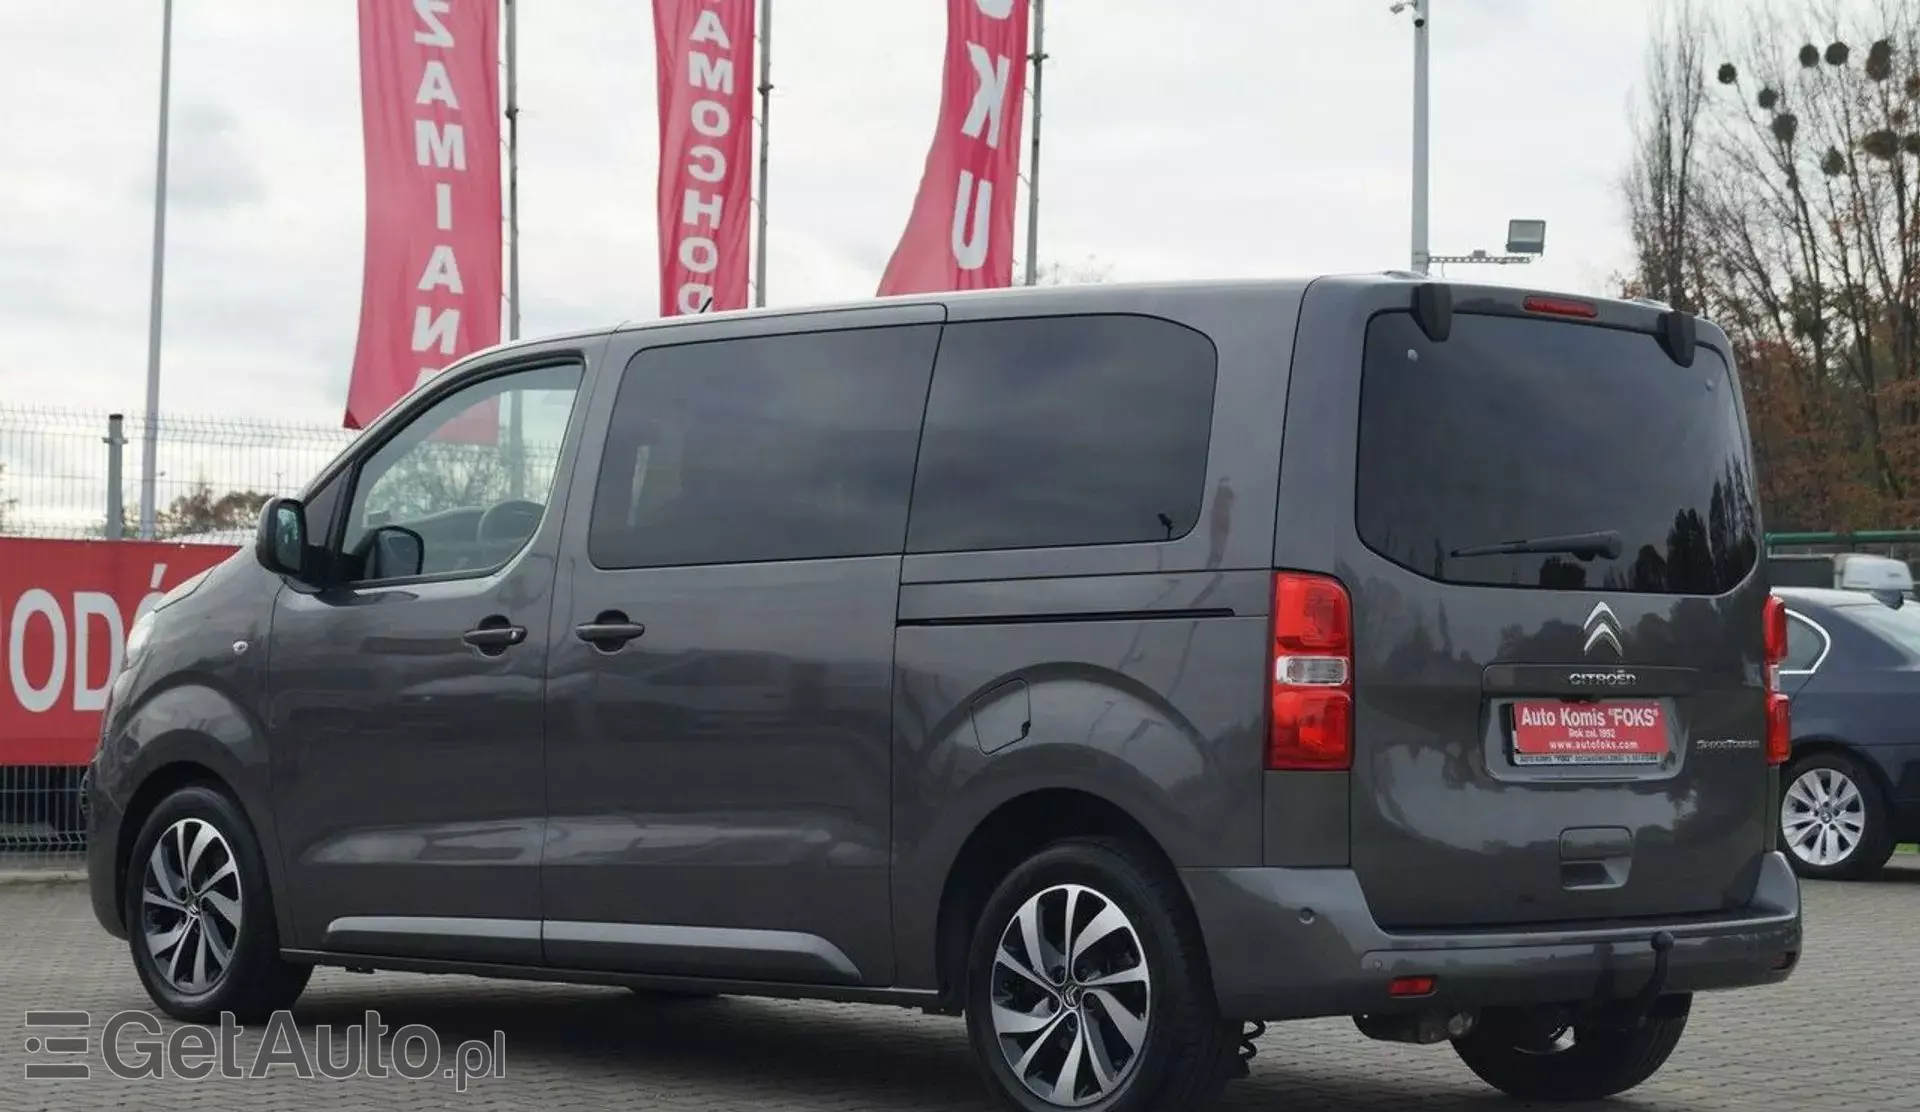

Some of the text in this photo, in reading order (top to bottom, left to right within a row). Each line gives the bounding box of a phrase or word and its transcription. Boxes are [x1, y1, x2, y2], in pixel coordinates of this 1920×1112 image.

[1521, 707, 1659, 727] Auto Komis "FOKS"
[1549, 739, 1638, 749] www.autofoks.com
